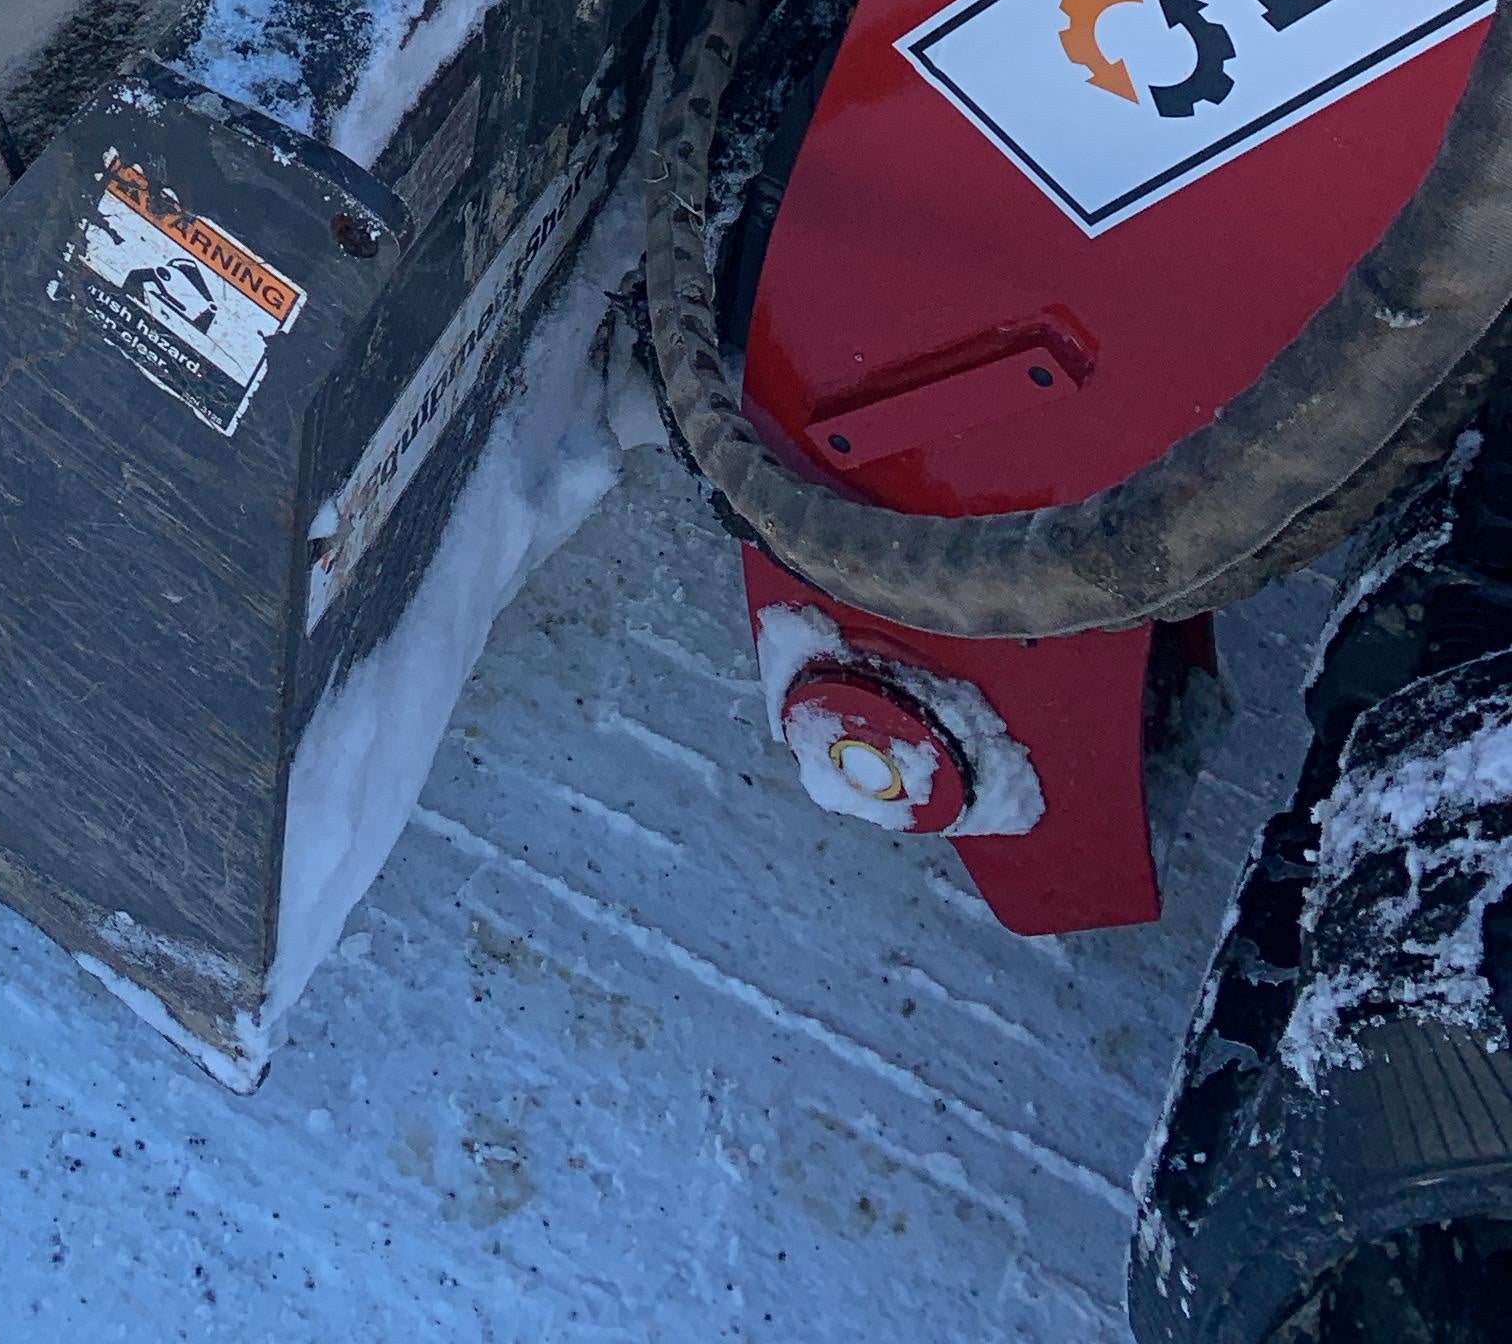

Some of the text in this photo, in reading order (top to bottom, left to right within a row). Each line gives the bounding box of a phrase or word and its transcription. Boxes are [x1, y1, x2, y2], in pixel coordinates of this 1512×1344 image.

[152, 203, 290, 312] ARNING
[86, 284, 206, 379] rush hazard.
[120, 327, 173, 374] clear.
